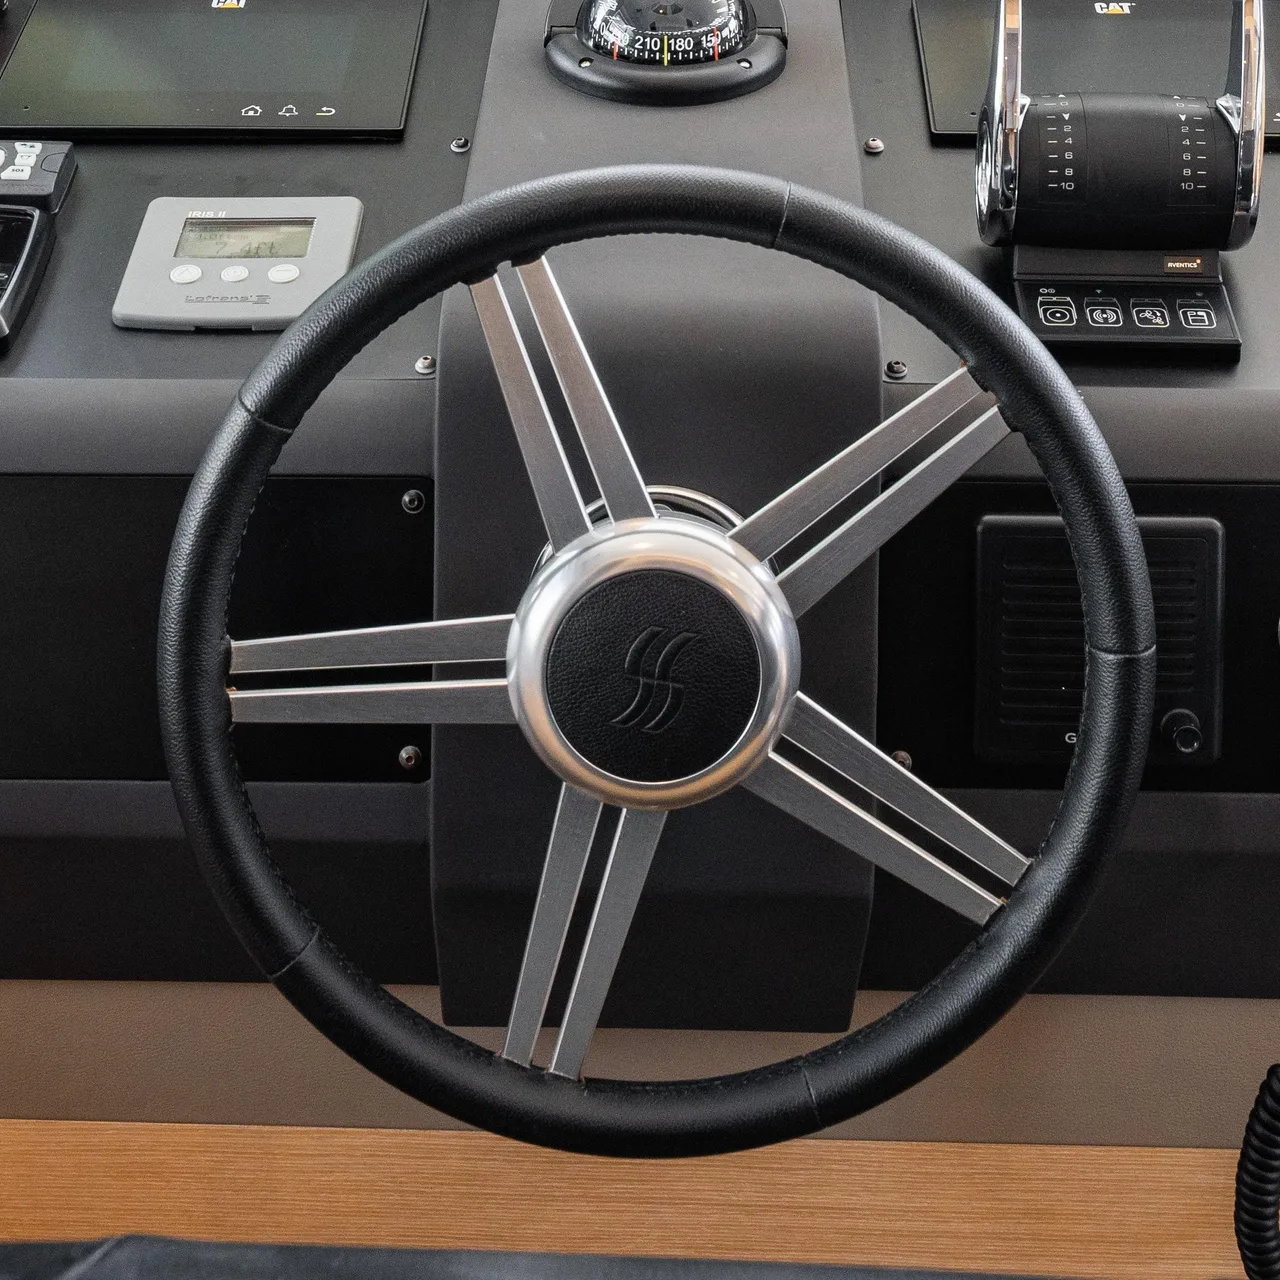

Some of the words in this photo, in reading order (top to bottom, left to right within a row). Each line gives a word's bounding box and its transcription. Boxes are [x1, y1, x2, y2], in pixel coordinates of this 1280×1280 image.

[1093, 1, 1131, 15] CAT
[634, 35, 661, 51] 210
[668, 37, 694, 51] 180
[1183, 153, 1191, 161] 6
[1064, 168, 1074, 176] 8
[1183, 168, 1192, 176] 8
[1060, 182, 1075, 190] 10
[1180, 183, 1194, 191] 10
